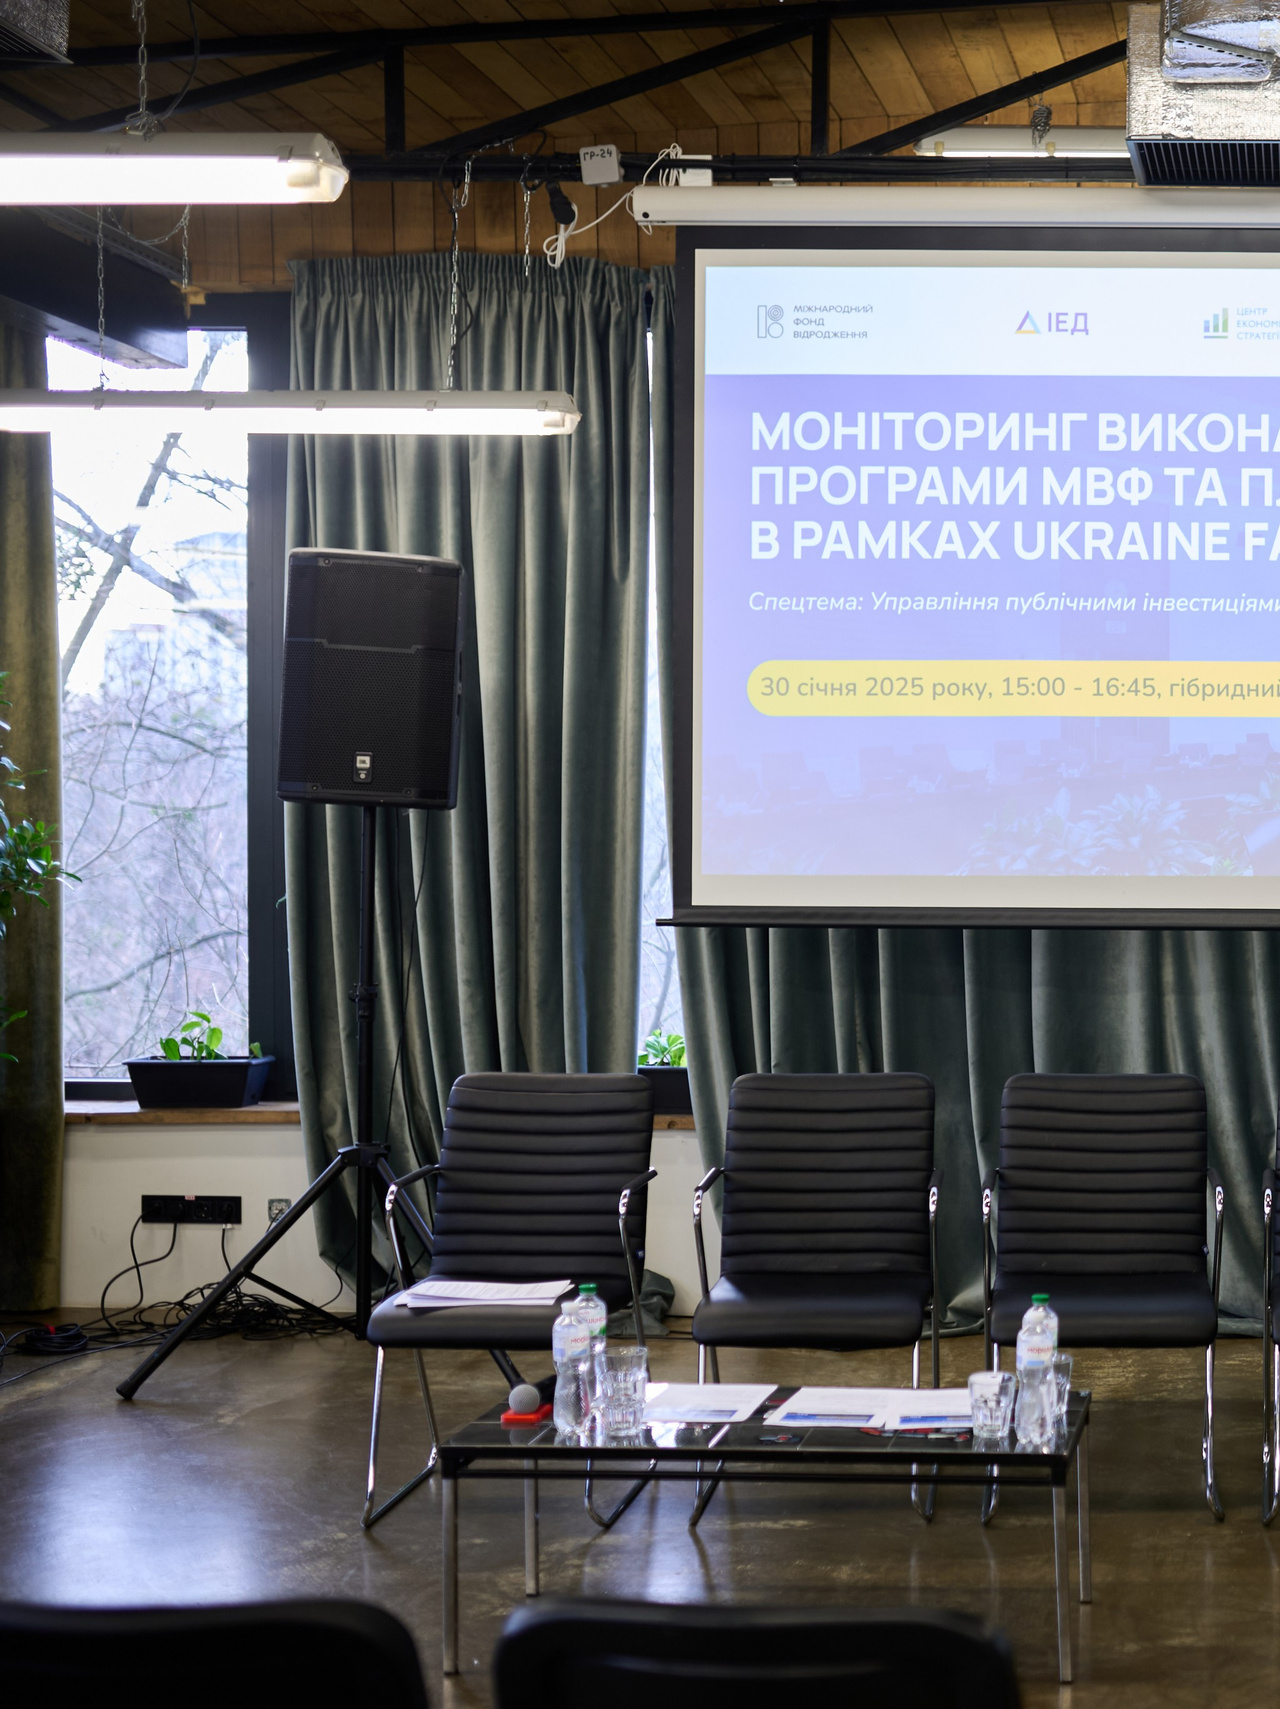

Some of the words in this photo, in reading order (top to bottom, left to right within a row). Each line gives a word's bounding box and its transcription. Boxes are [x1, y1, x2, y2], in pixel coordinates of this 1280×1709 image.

[793, 304, 873, 314] МІЖНАРОДНИЙ
[1236, 307, 1269, 317] ЦЕНТР
[793, 317, 825, 327] ФОНД
[1047, 312, 1089, 336] ІЕД
[793, 330, 868, 340] ВІДРОДЖЕННЯ
[753, 412, 1087, 451] МОНІТОРИНГ
[752, 466, 1027, 505] ПРОГРАМИ
[1043, 467, 1152, 505] МВФ
[1164, 468, 1227, 506] ТА
[752, 521, 779, 559] В
[794, 521, 1000, 559] РАМКАХ
[1015, 522, 1230, 560] UKRAINE
[749, 592, 863, 613] Спецтема:
[872, 592, 998, 614] Управління
[1006, 592, 1136, 614] публічними
[761, 677, 789, 696] 30
[798, 678, 856, 696] січня
[866, 677, 923, 696] 2025
[933, 683, 992, 700] року,
[1003, 677, 1065, 696] 15:00
[1093, 678, 1161, 699] 16:45,
